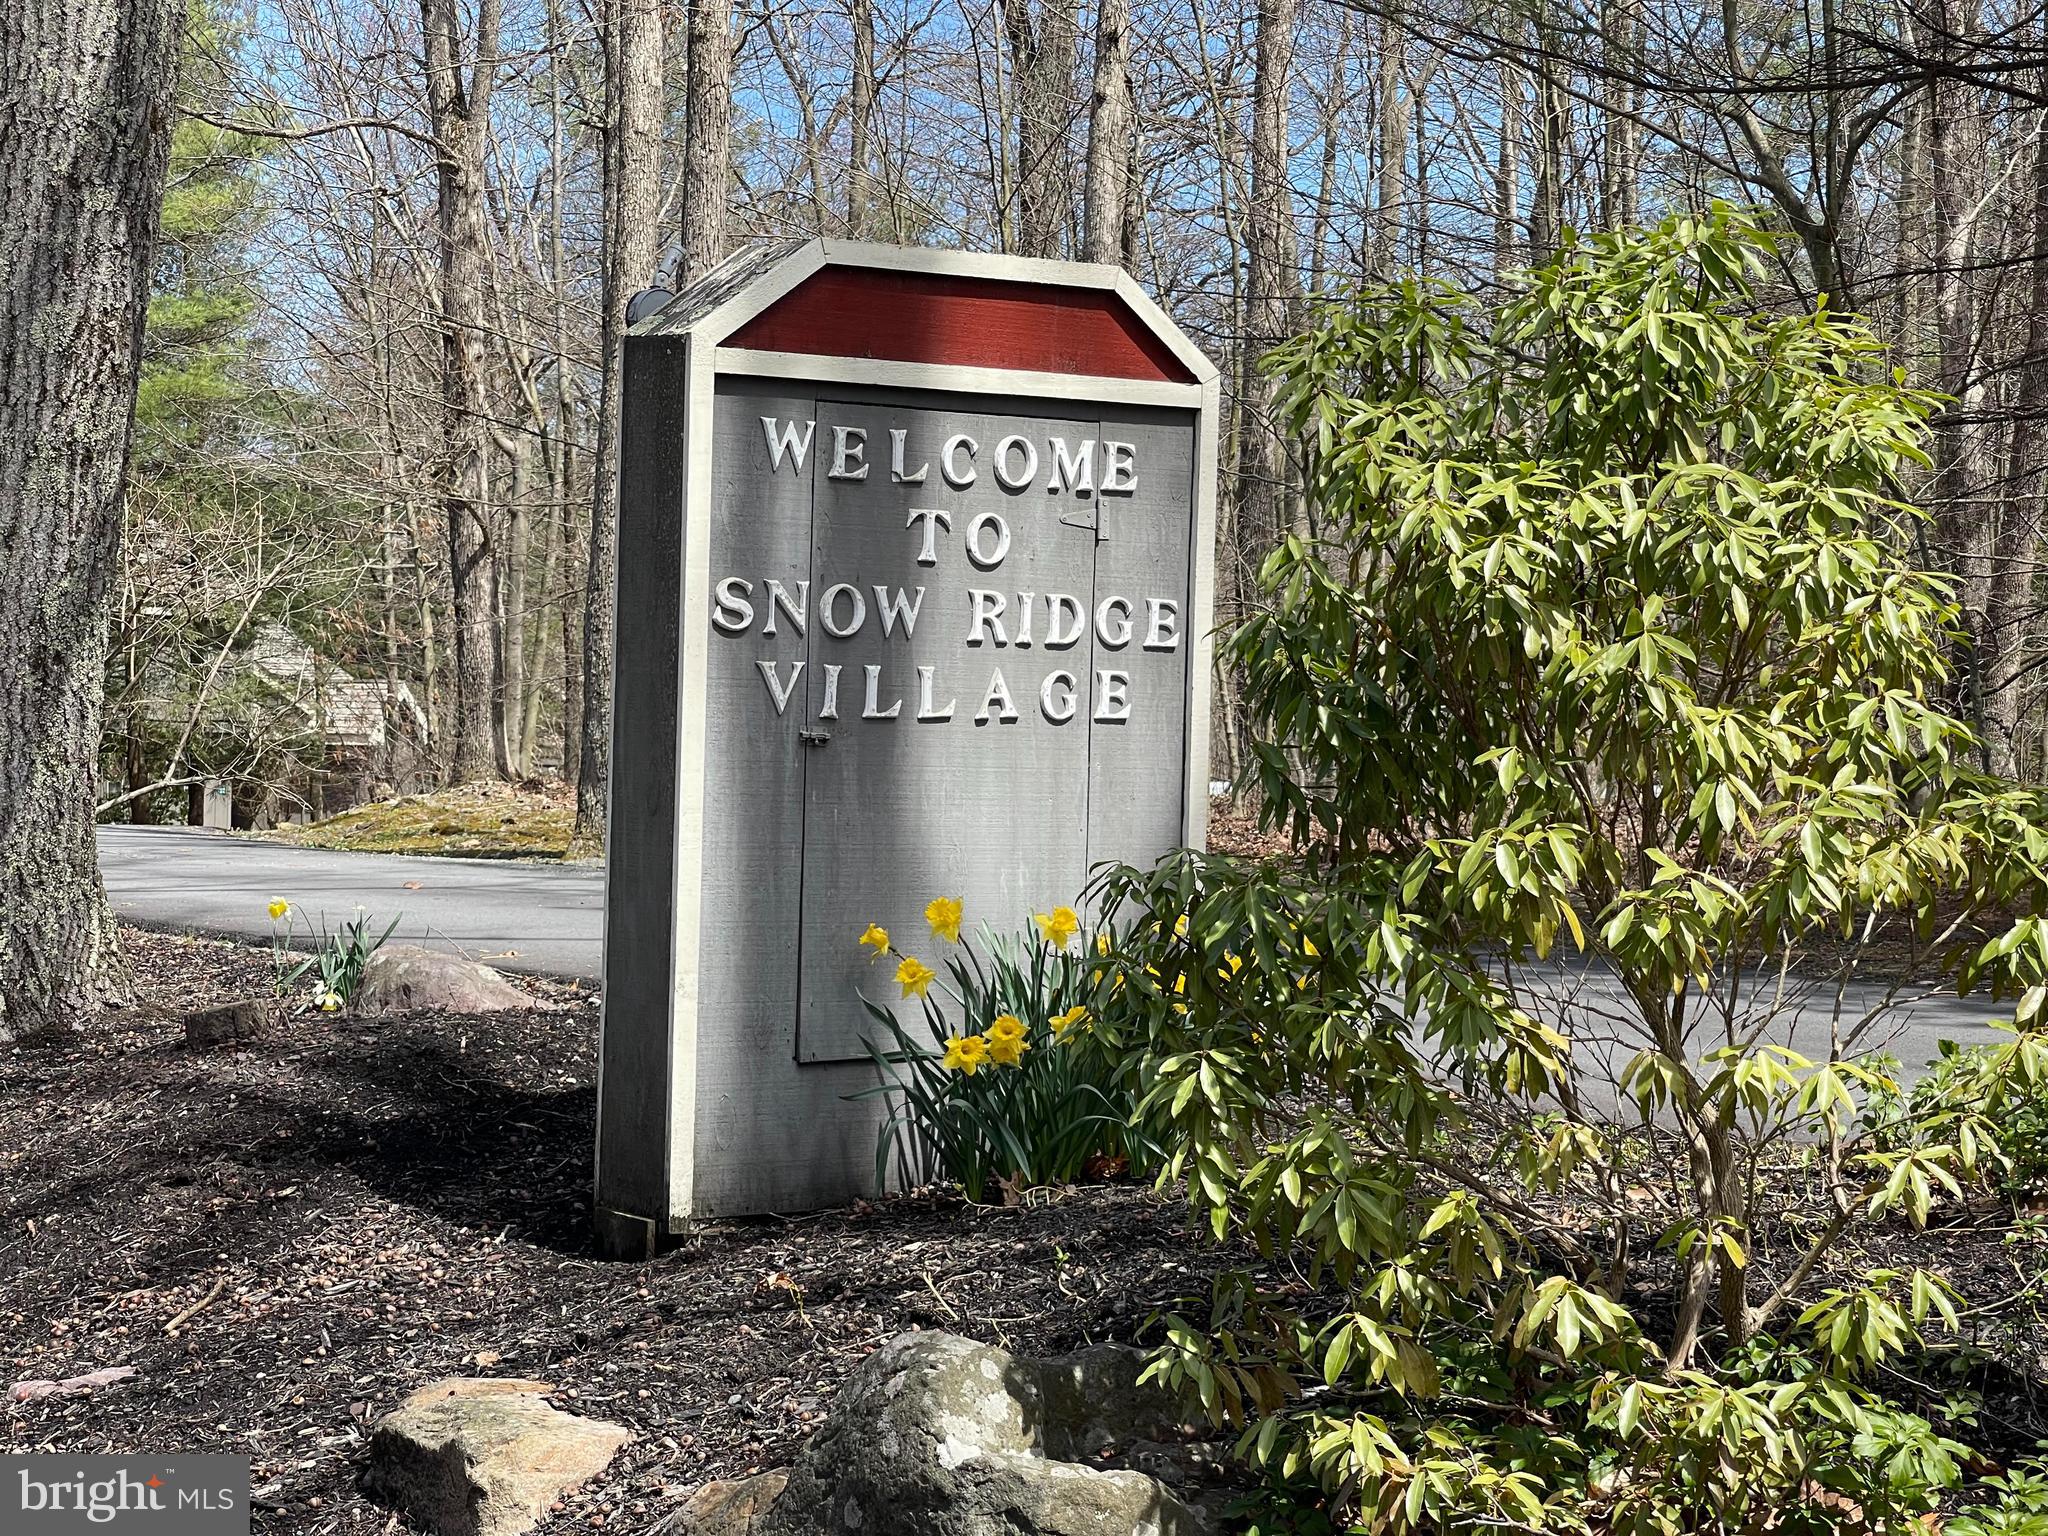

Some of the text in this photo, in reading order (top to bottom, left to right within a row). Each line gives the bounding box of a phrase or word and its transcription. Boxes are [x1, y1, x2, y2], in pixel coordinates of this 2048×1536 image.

[760, 416, 1138, 494] WELCOME
[906, 508, 1011, 567] TO
[712, 576, 1181, 650] SNOW RIDGE
[755, 660, 1132, 725] VILLAGE
